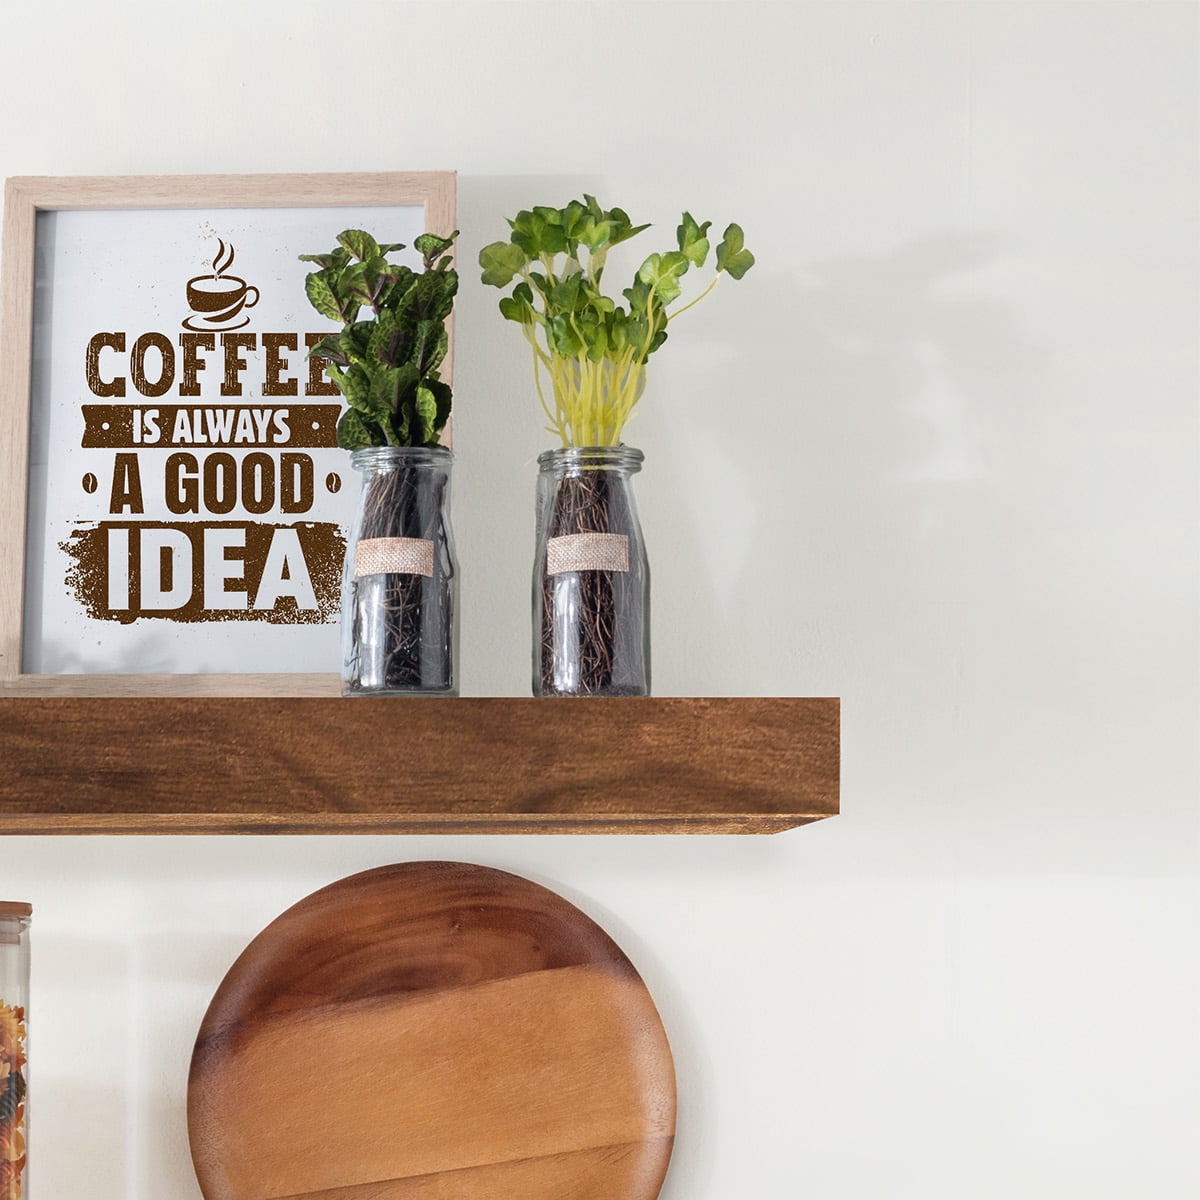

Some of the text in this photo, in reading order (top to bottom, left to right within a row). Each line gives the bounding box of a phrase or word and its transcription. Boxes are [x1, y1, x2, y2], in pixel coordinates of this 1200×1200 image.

[86, 333, 341, 397] COFFEE
[134, 409, 291, 444] IS ALWAYS
[109, 453, 314, 514] A GOOD
[108, 528, 318, 611] IDEA
